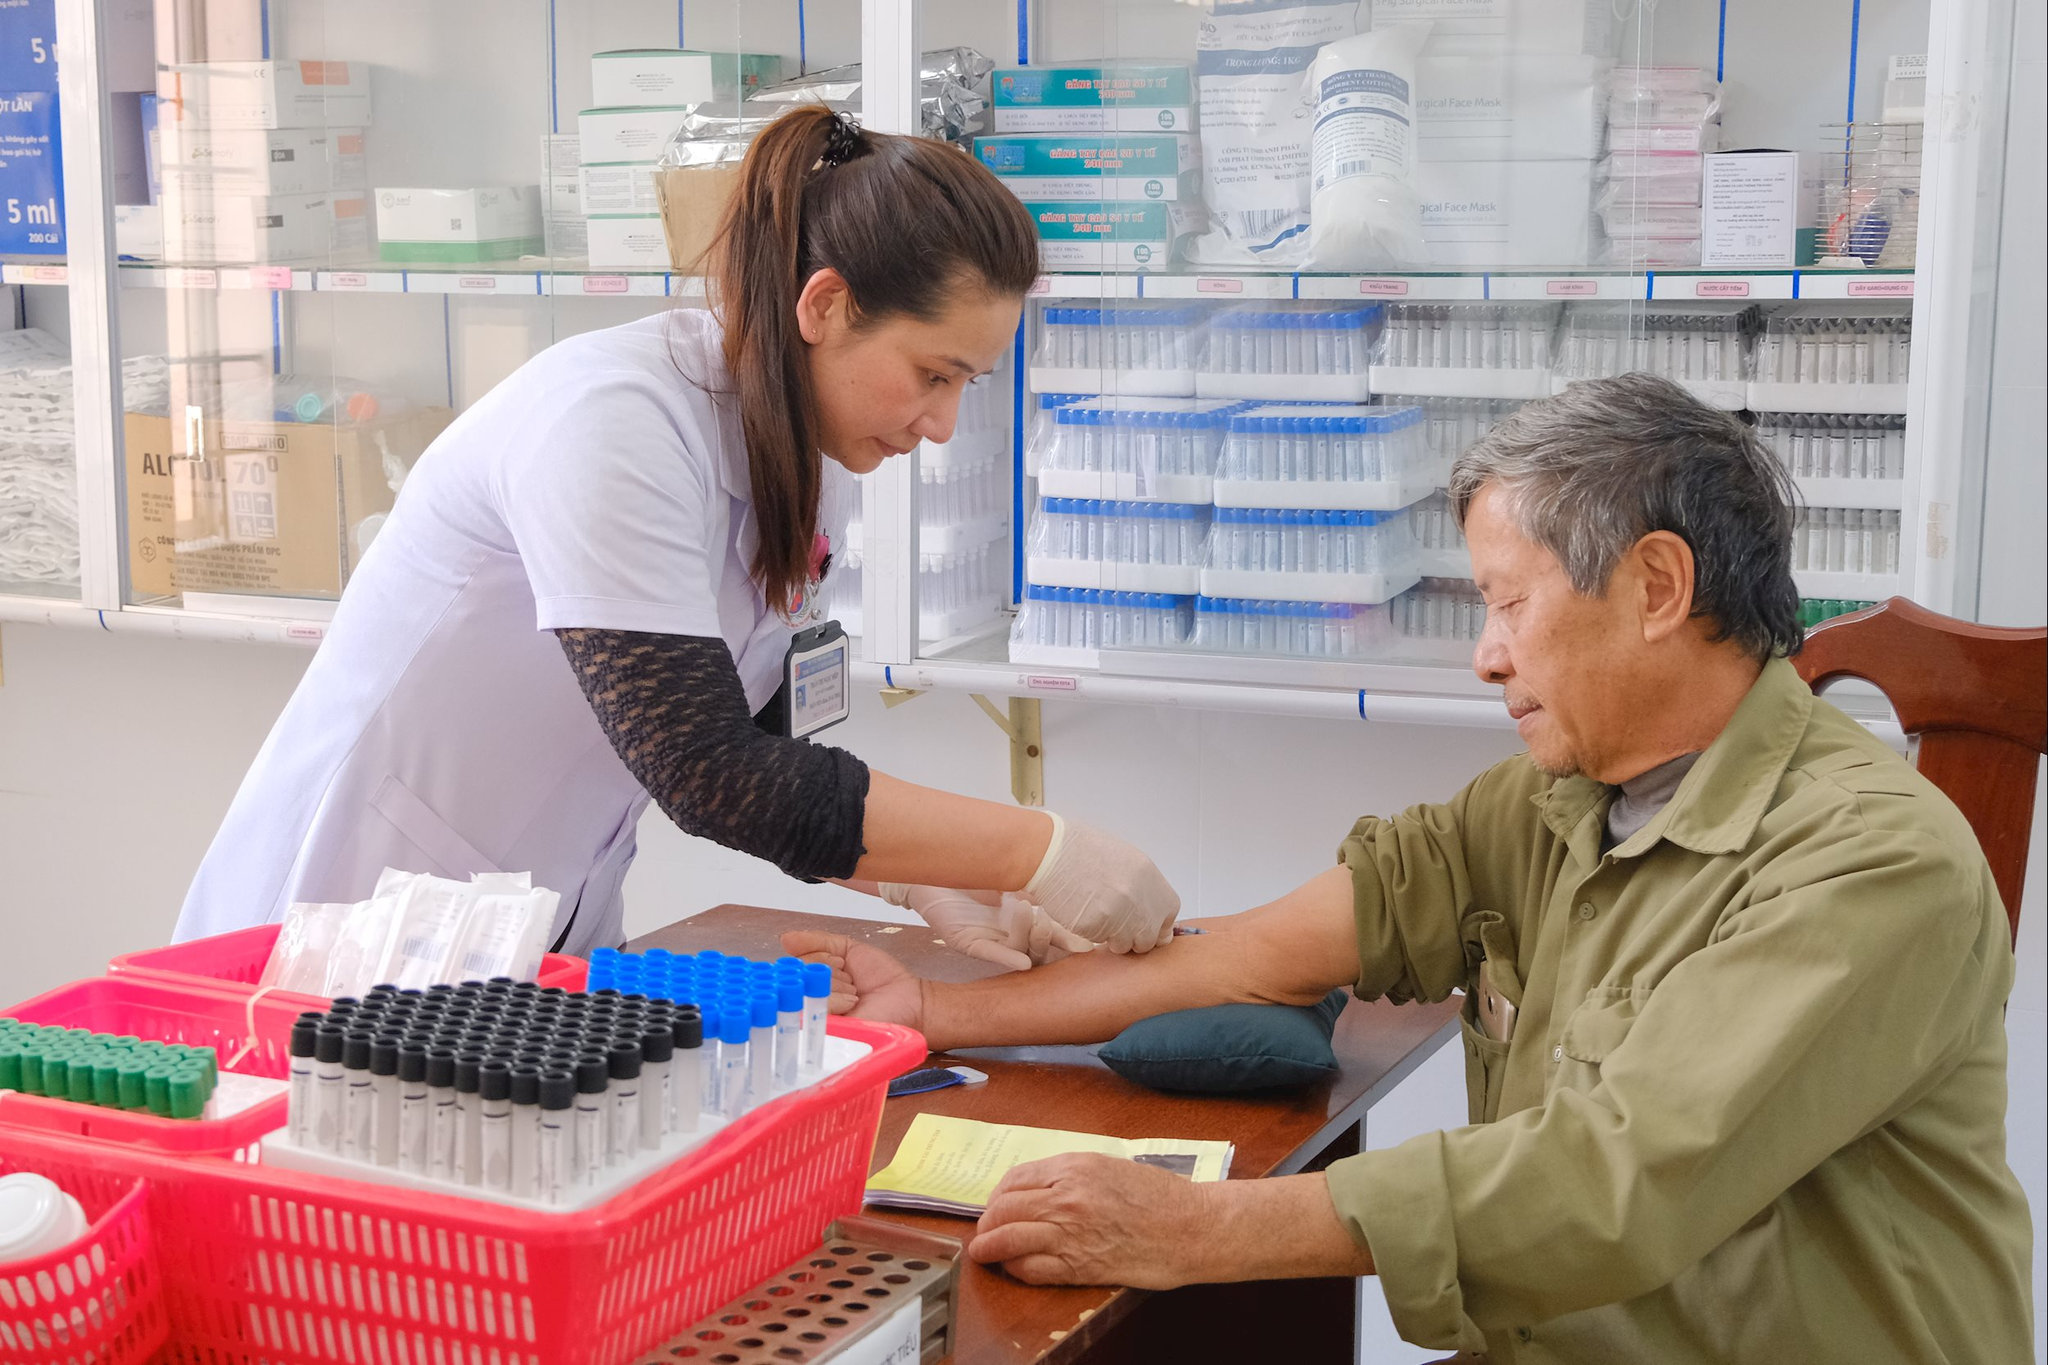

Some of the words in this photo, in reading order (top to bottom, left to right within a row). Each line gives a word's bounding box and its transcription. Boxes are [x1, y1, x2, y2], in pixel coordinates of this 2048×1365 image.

[31, 37, 46, 63] 5
[1416, 97, 1448, 110] urgical
[7, 198, 21, 224] 5
[27, 198, 57, 224] ml
[1419, 202, 1442, 214] gical
[1444, 202, 1468, 212] Face
[1469, 202, 1497, 212] Mask
